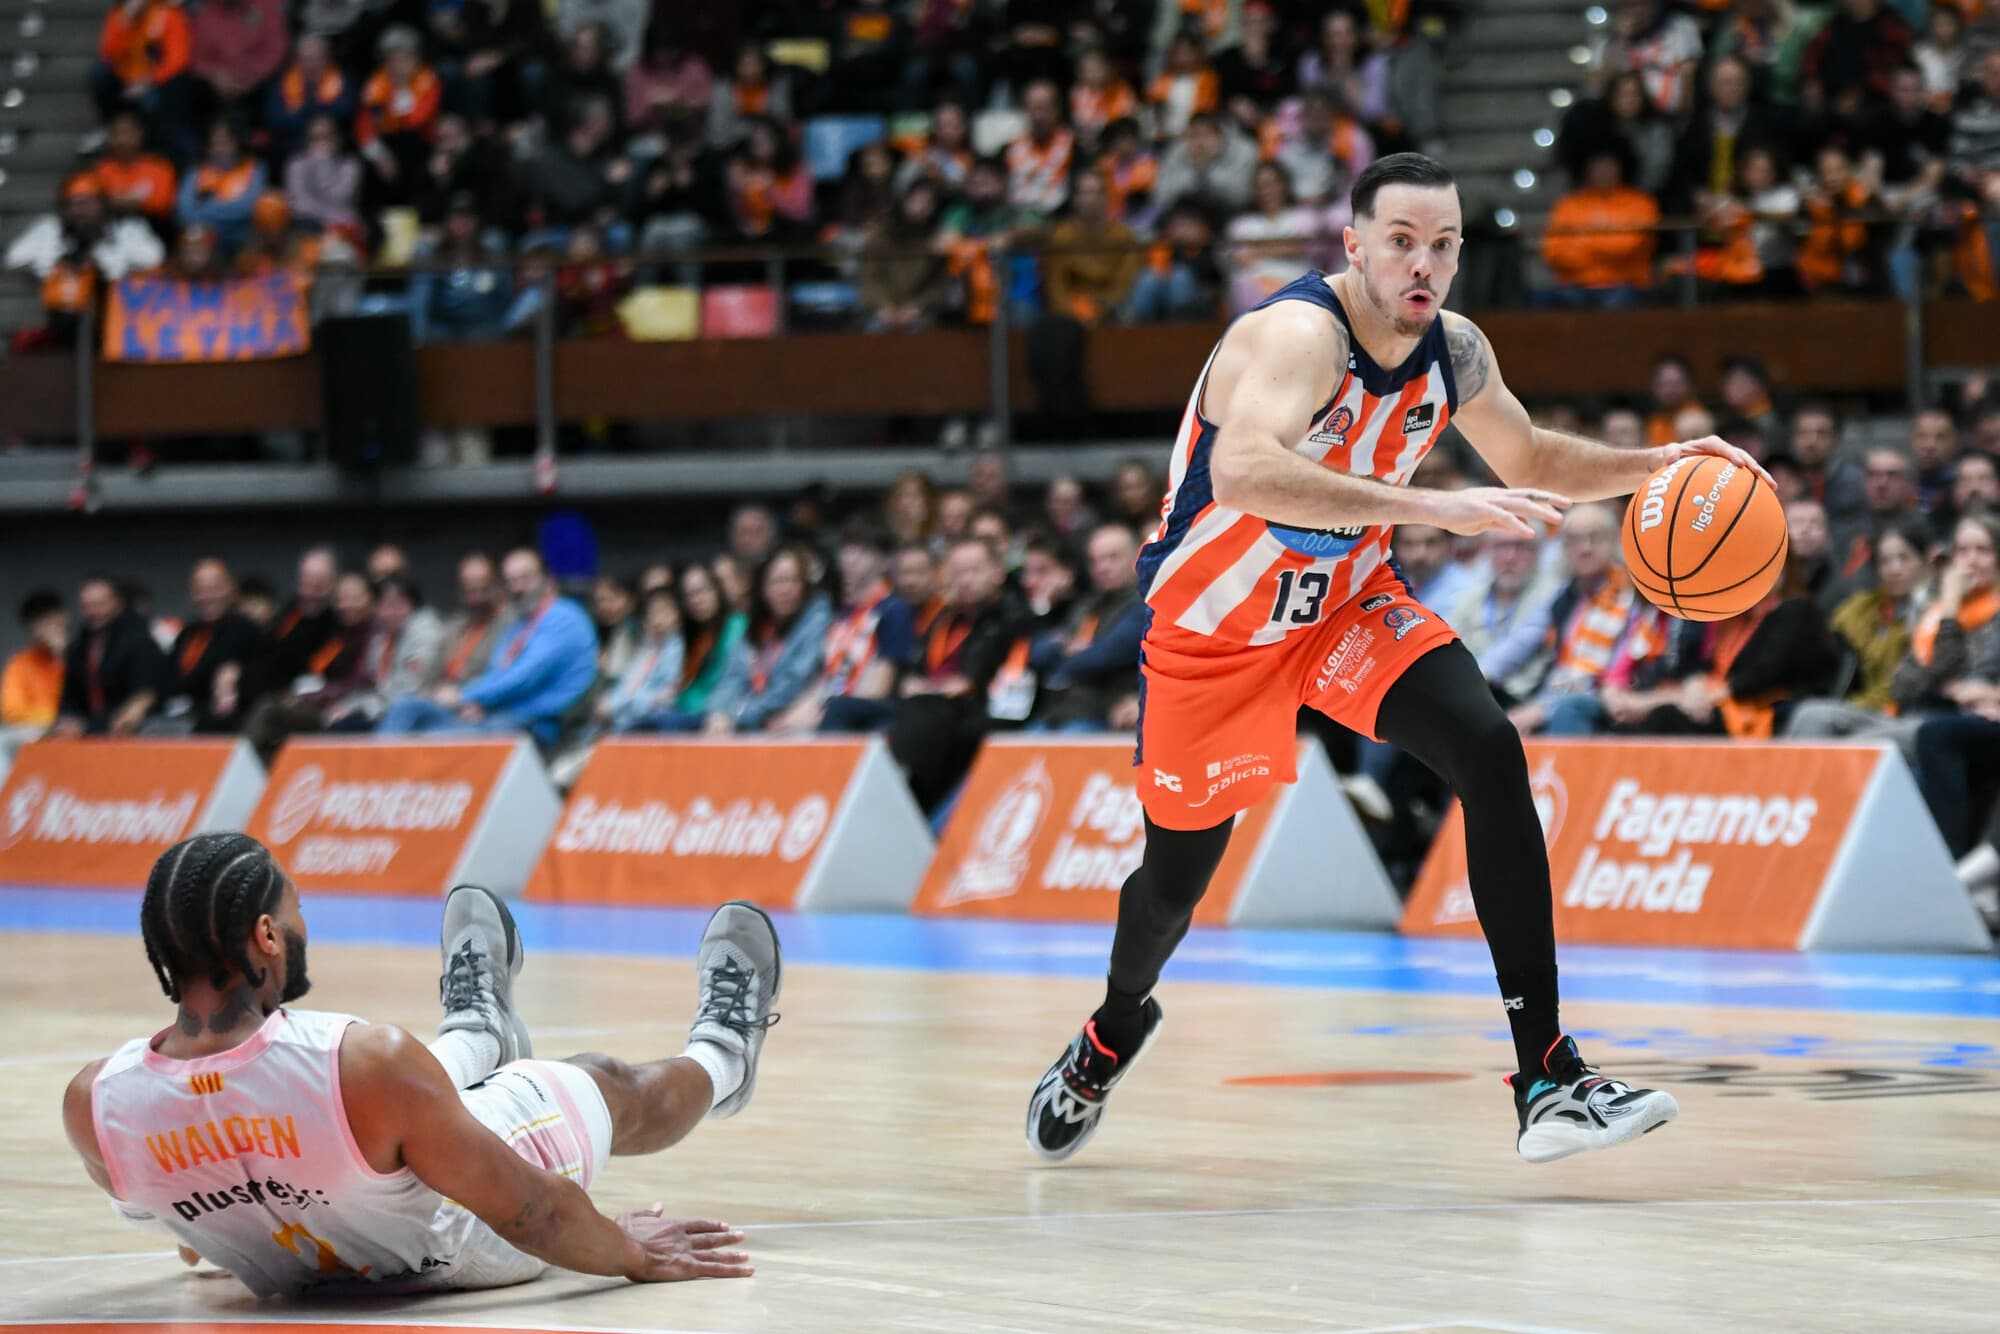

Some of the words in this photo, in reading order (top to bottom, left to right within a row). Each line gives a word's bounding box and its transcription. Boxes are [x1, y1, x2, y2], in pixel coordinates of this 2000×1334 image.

[1691, 502, 1715, 532] liga
[1271, 571, 1329, 625] 13
[1366, 598, 1387, 610] acb
[1316, 677, 1327, 692] A
[1188, 766, 1270, 808] galicia
[1593, 778, 1818, 857] Fagamos
[1041, 830, 1147, 891] lend
[1563, 846, 1714, 914] lenda
[145, 1114, 302, 1174] WALDEN
